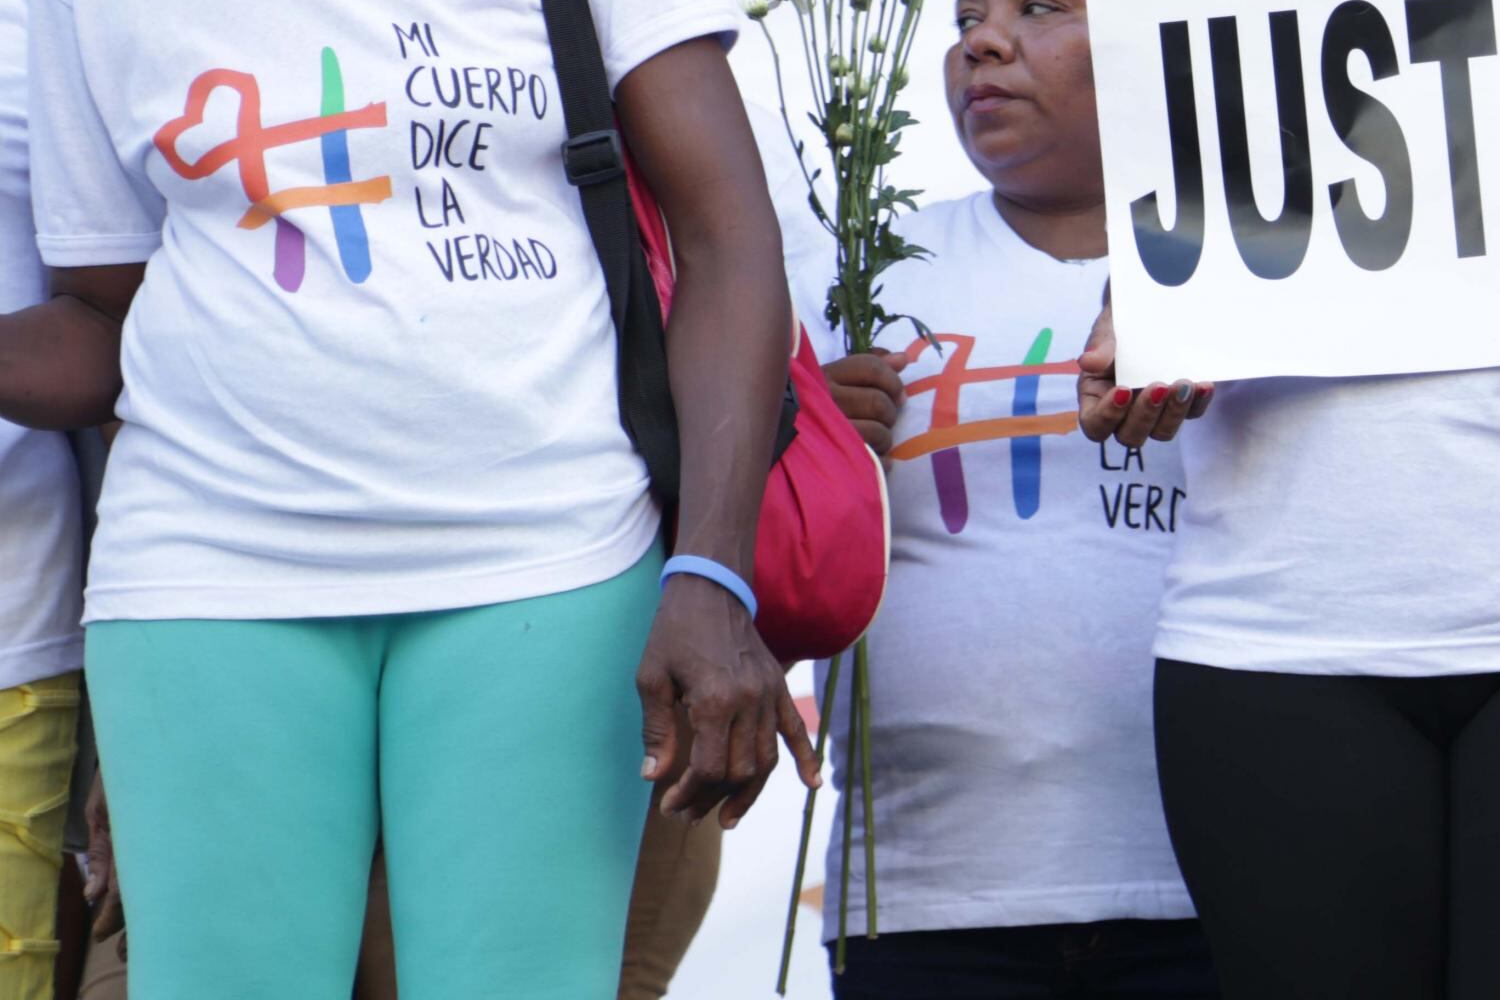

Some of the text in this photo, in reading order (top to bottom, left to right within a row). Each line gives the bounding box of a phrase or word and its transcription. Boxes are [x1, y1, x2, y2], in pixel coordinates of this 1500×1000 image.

[392, 22, 439, 59] MI
[405, 65, 547, 120] CUERPO
[411, 118, 494, 171] DICE
[415, 177, 465, 228] LA
[427, 234, 557, 282] VERDAD
[1099, 483, 1187, 533] VER
